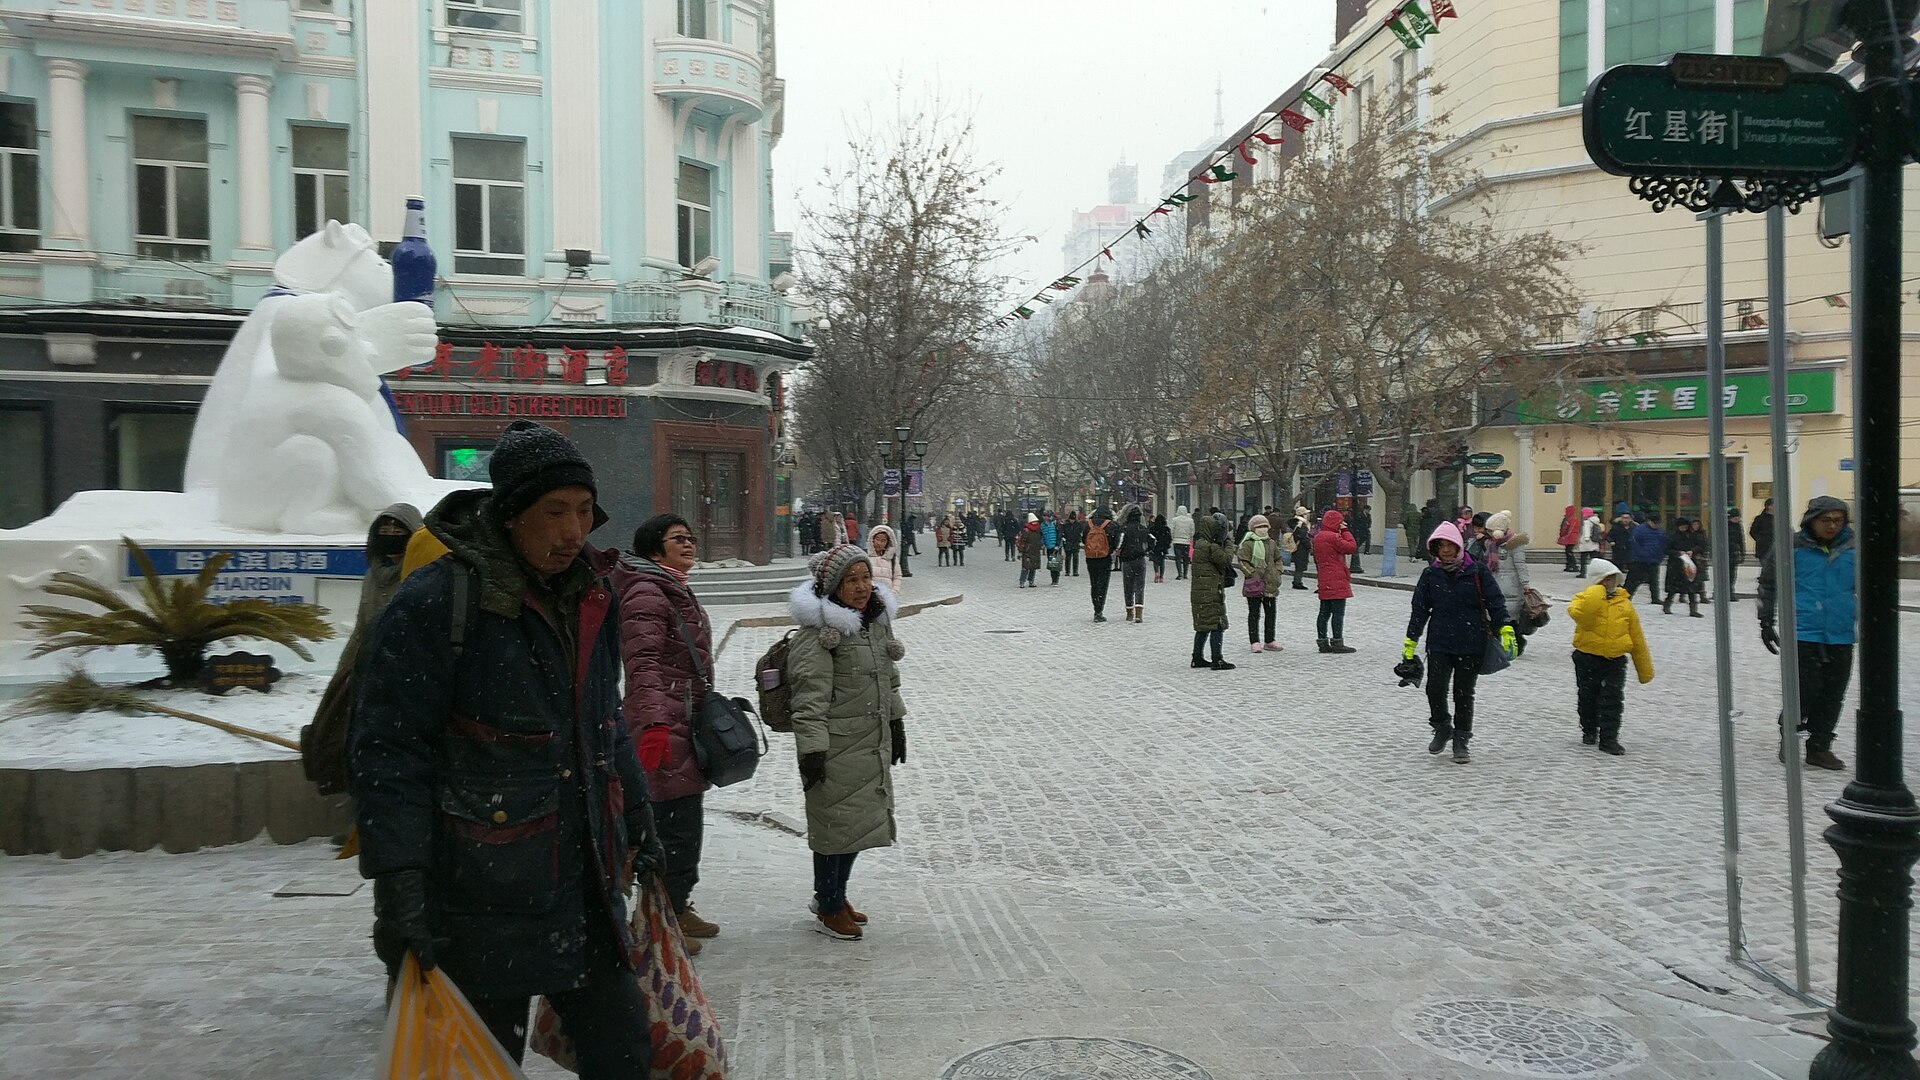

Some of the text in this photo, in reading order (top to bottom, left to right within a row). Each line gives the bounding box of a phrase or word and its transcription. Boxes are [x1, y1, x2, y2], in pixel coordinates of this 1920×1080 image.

[1624, 106, 1728, 145] 红星街
[397, 342, 628, 385] 年老街酒店
[470, 395, 500, 415] OLD
[214, 577, 292, 591] HARBIN
